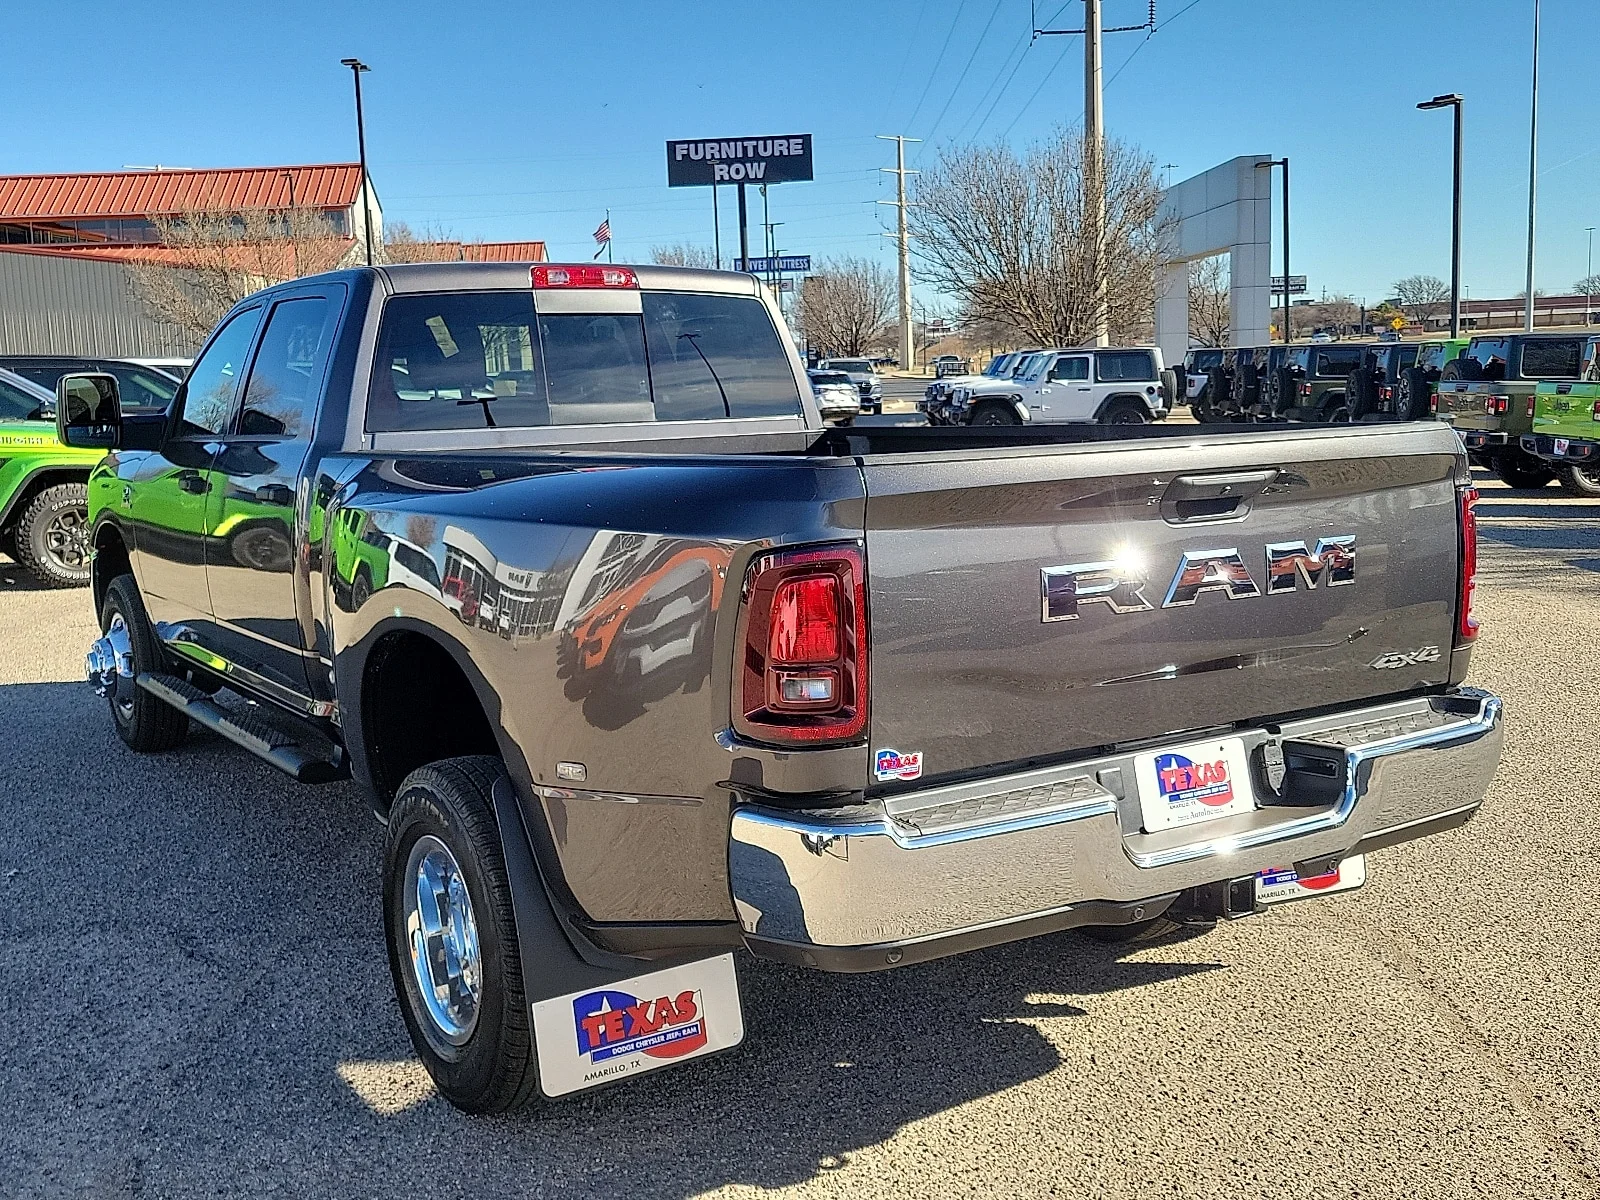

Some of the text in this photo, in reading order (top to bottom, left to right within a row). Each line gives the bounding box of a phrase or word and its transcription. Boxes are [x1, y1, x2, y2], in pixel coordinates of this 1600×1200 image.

[675, 138, 804, 161] FURNITURE
[714, 161, 767, 181] ROW
[1040, 534, 1356, 623] RAM
[1160, 759, 1227, 793] TEXAS
[581, 990, 698, 1048] TEXAS
[612, 1043, 635, 1055] DODGE
[635, 1035, 665, 1049] CHRYSLER
[682, 1026, 698, 1036] RAM
[583, 1060, 642, 1082] AMARILLO, TX
